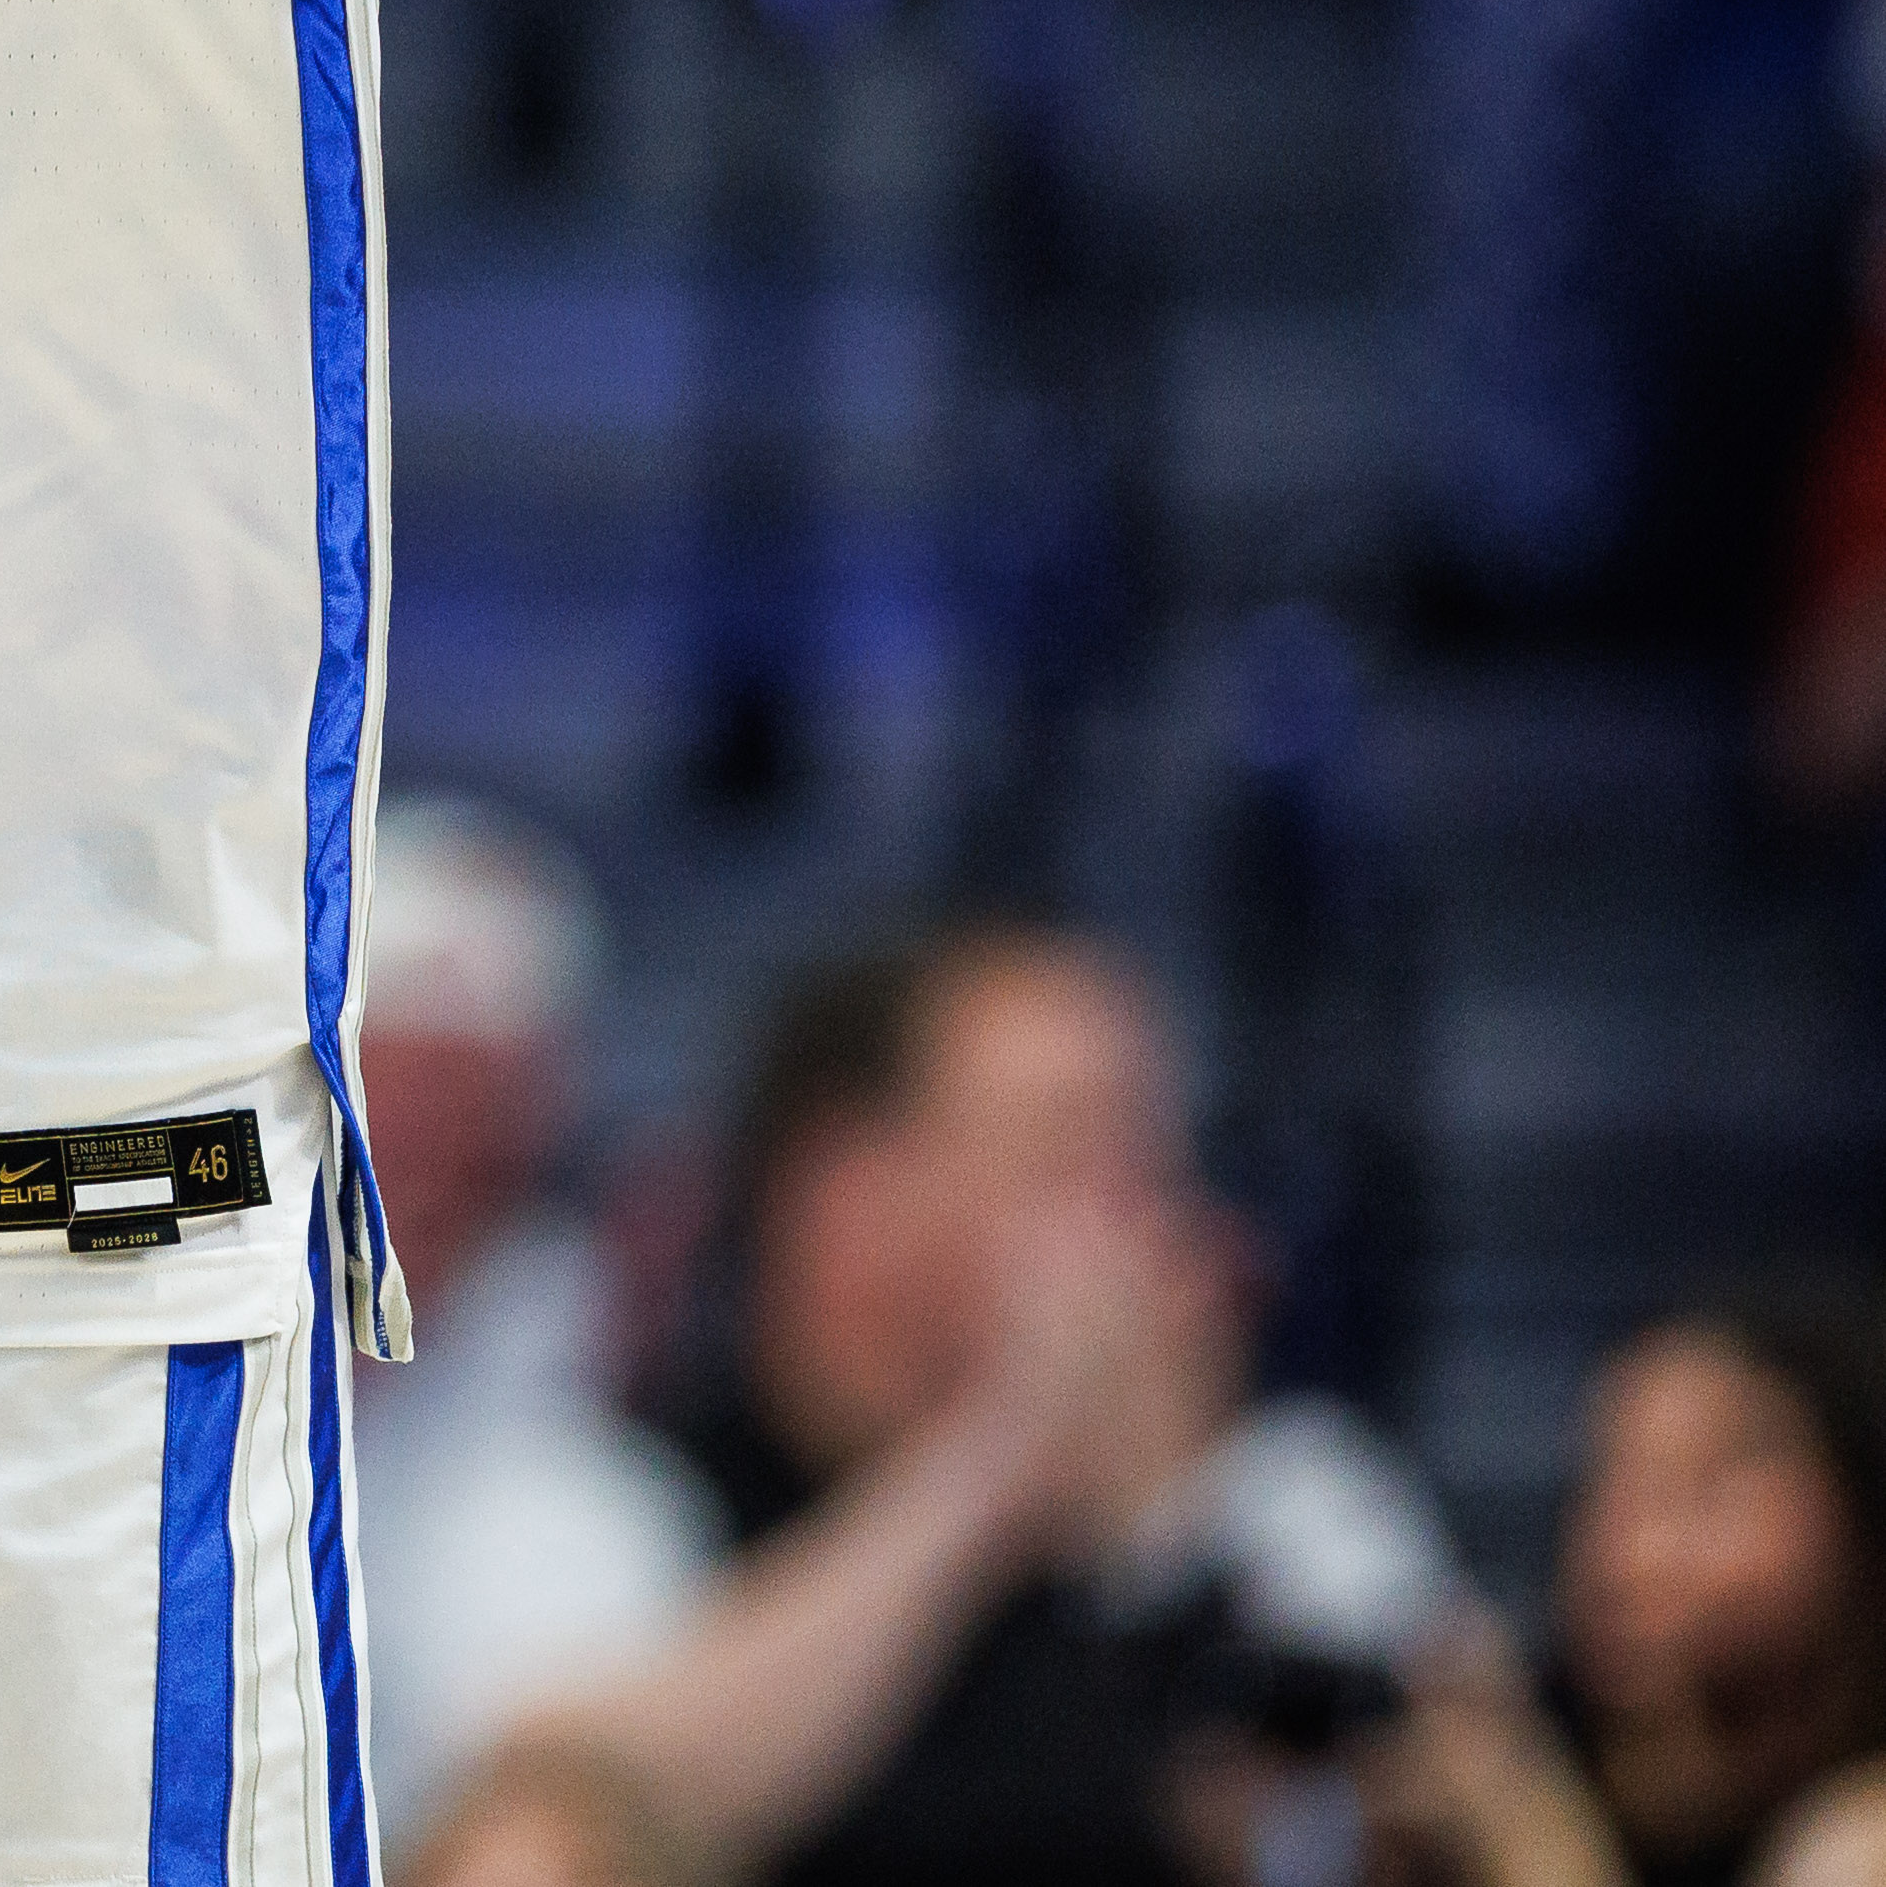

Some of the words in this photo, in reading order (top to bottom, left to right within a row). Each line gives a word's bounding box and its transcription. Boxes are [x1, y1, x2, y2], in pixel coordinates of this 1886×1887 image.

[69, 1135, 165, 1156] ENGINEERED
[188, 1144, 228, 1183] 46
[0, 1184, 57, 1205] ELITE
